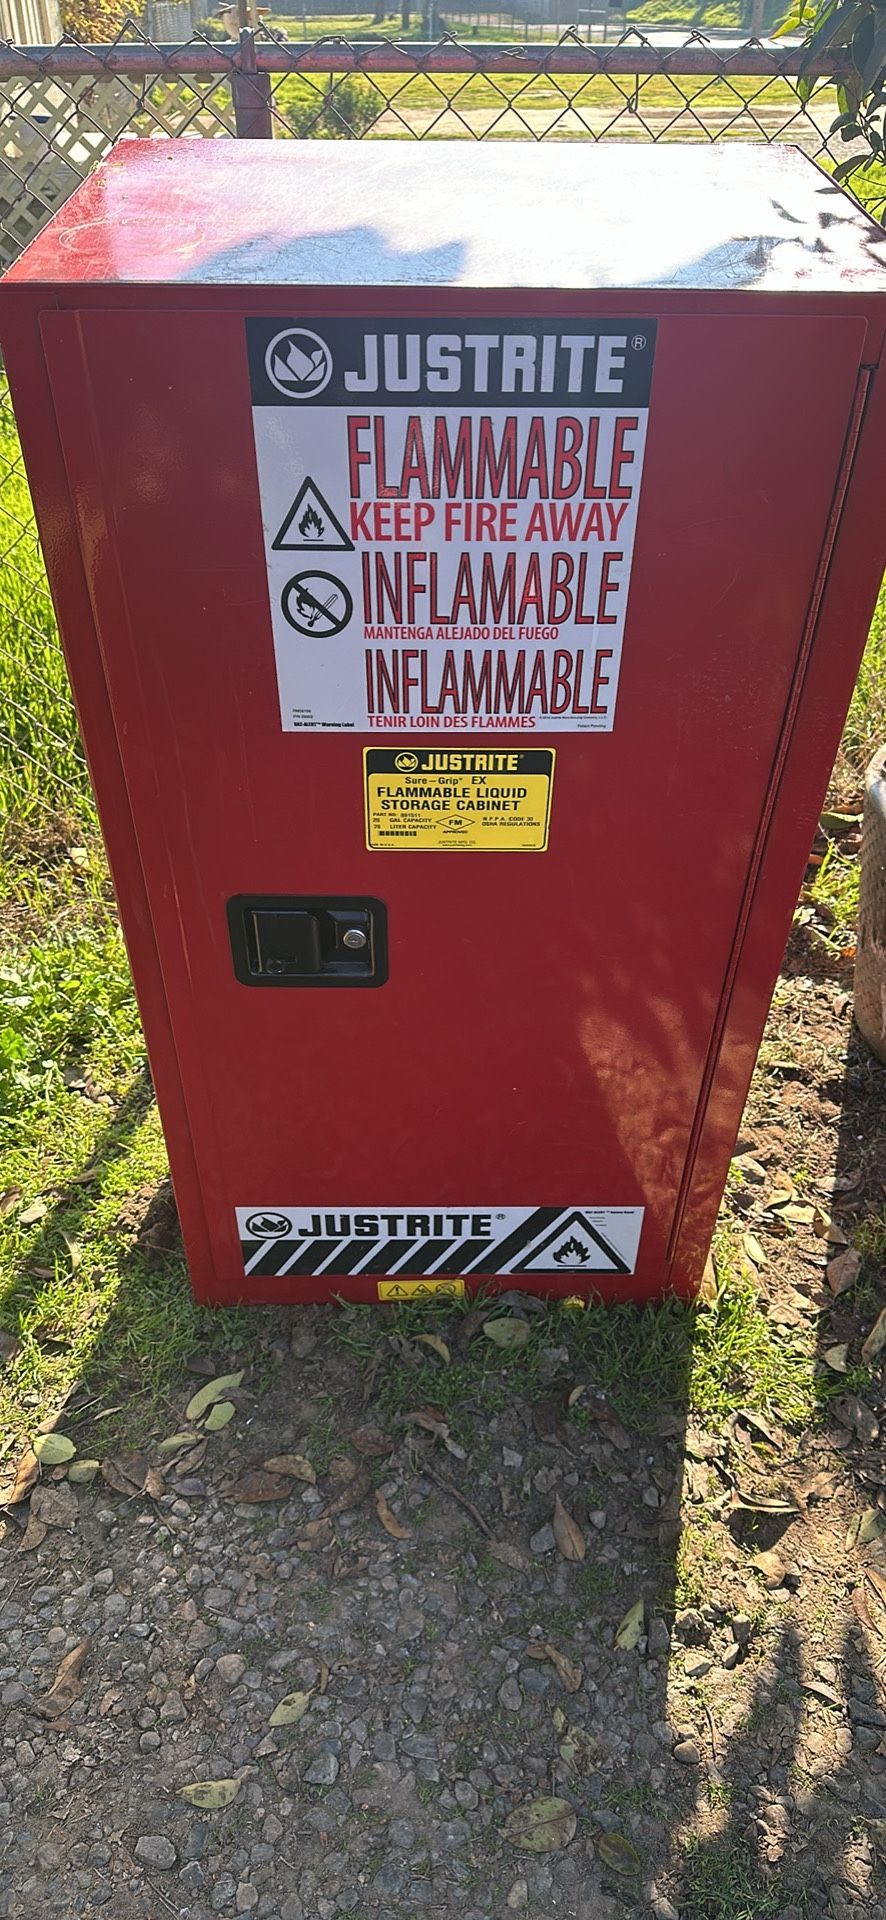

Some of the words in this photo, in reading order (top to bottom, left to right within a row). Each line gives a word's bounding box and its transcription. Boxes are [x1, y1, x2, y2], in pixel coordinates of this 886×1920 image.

[346, 415, 640, 499] FLAMMABLE
[350, 502, 435, 542] KEEP
[444, 502, 518, 542] FIRE
[524, 502, 629, 542] AWAY
[361, 551, 624, 625] INFLAMABLE
[363, 626, 434, 640] MANTENGA
[435, 626, 490, 641] ALEJADO
[493, 627, 516, 640] DEL
[518, 627, 559, 640] FUEGO
[364, 649, 613, 715] INFLAMMABLE
[367, 715, 407, 728] TENIR
[410, 716, 439, 728] LOIN
[444, 716, 467, 728] DES
[472, 716, 535, 728] FLAMMES
[471, 776, 487, 785] EX
[377, 787, 470, 798] FLAMMABLE
[476, 787, 527, 799] LIQUID
[381, 800, 450, 811] STORAGE
[456, 800, 520, 811] CABINET
